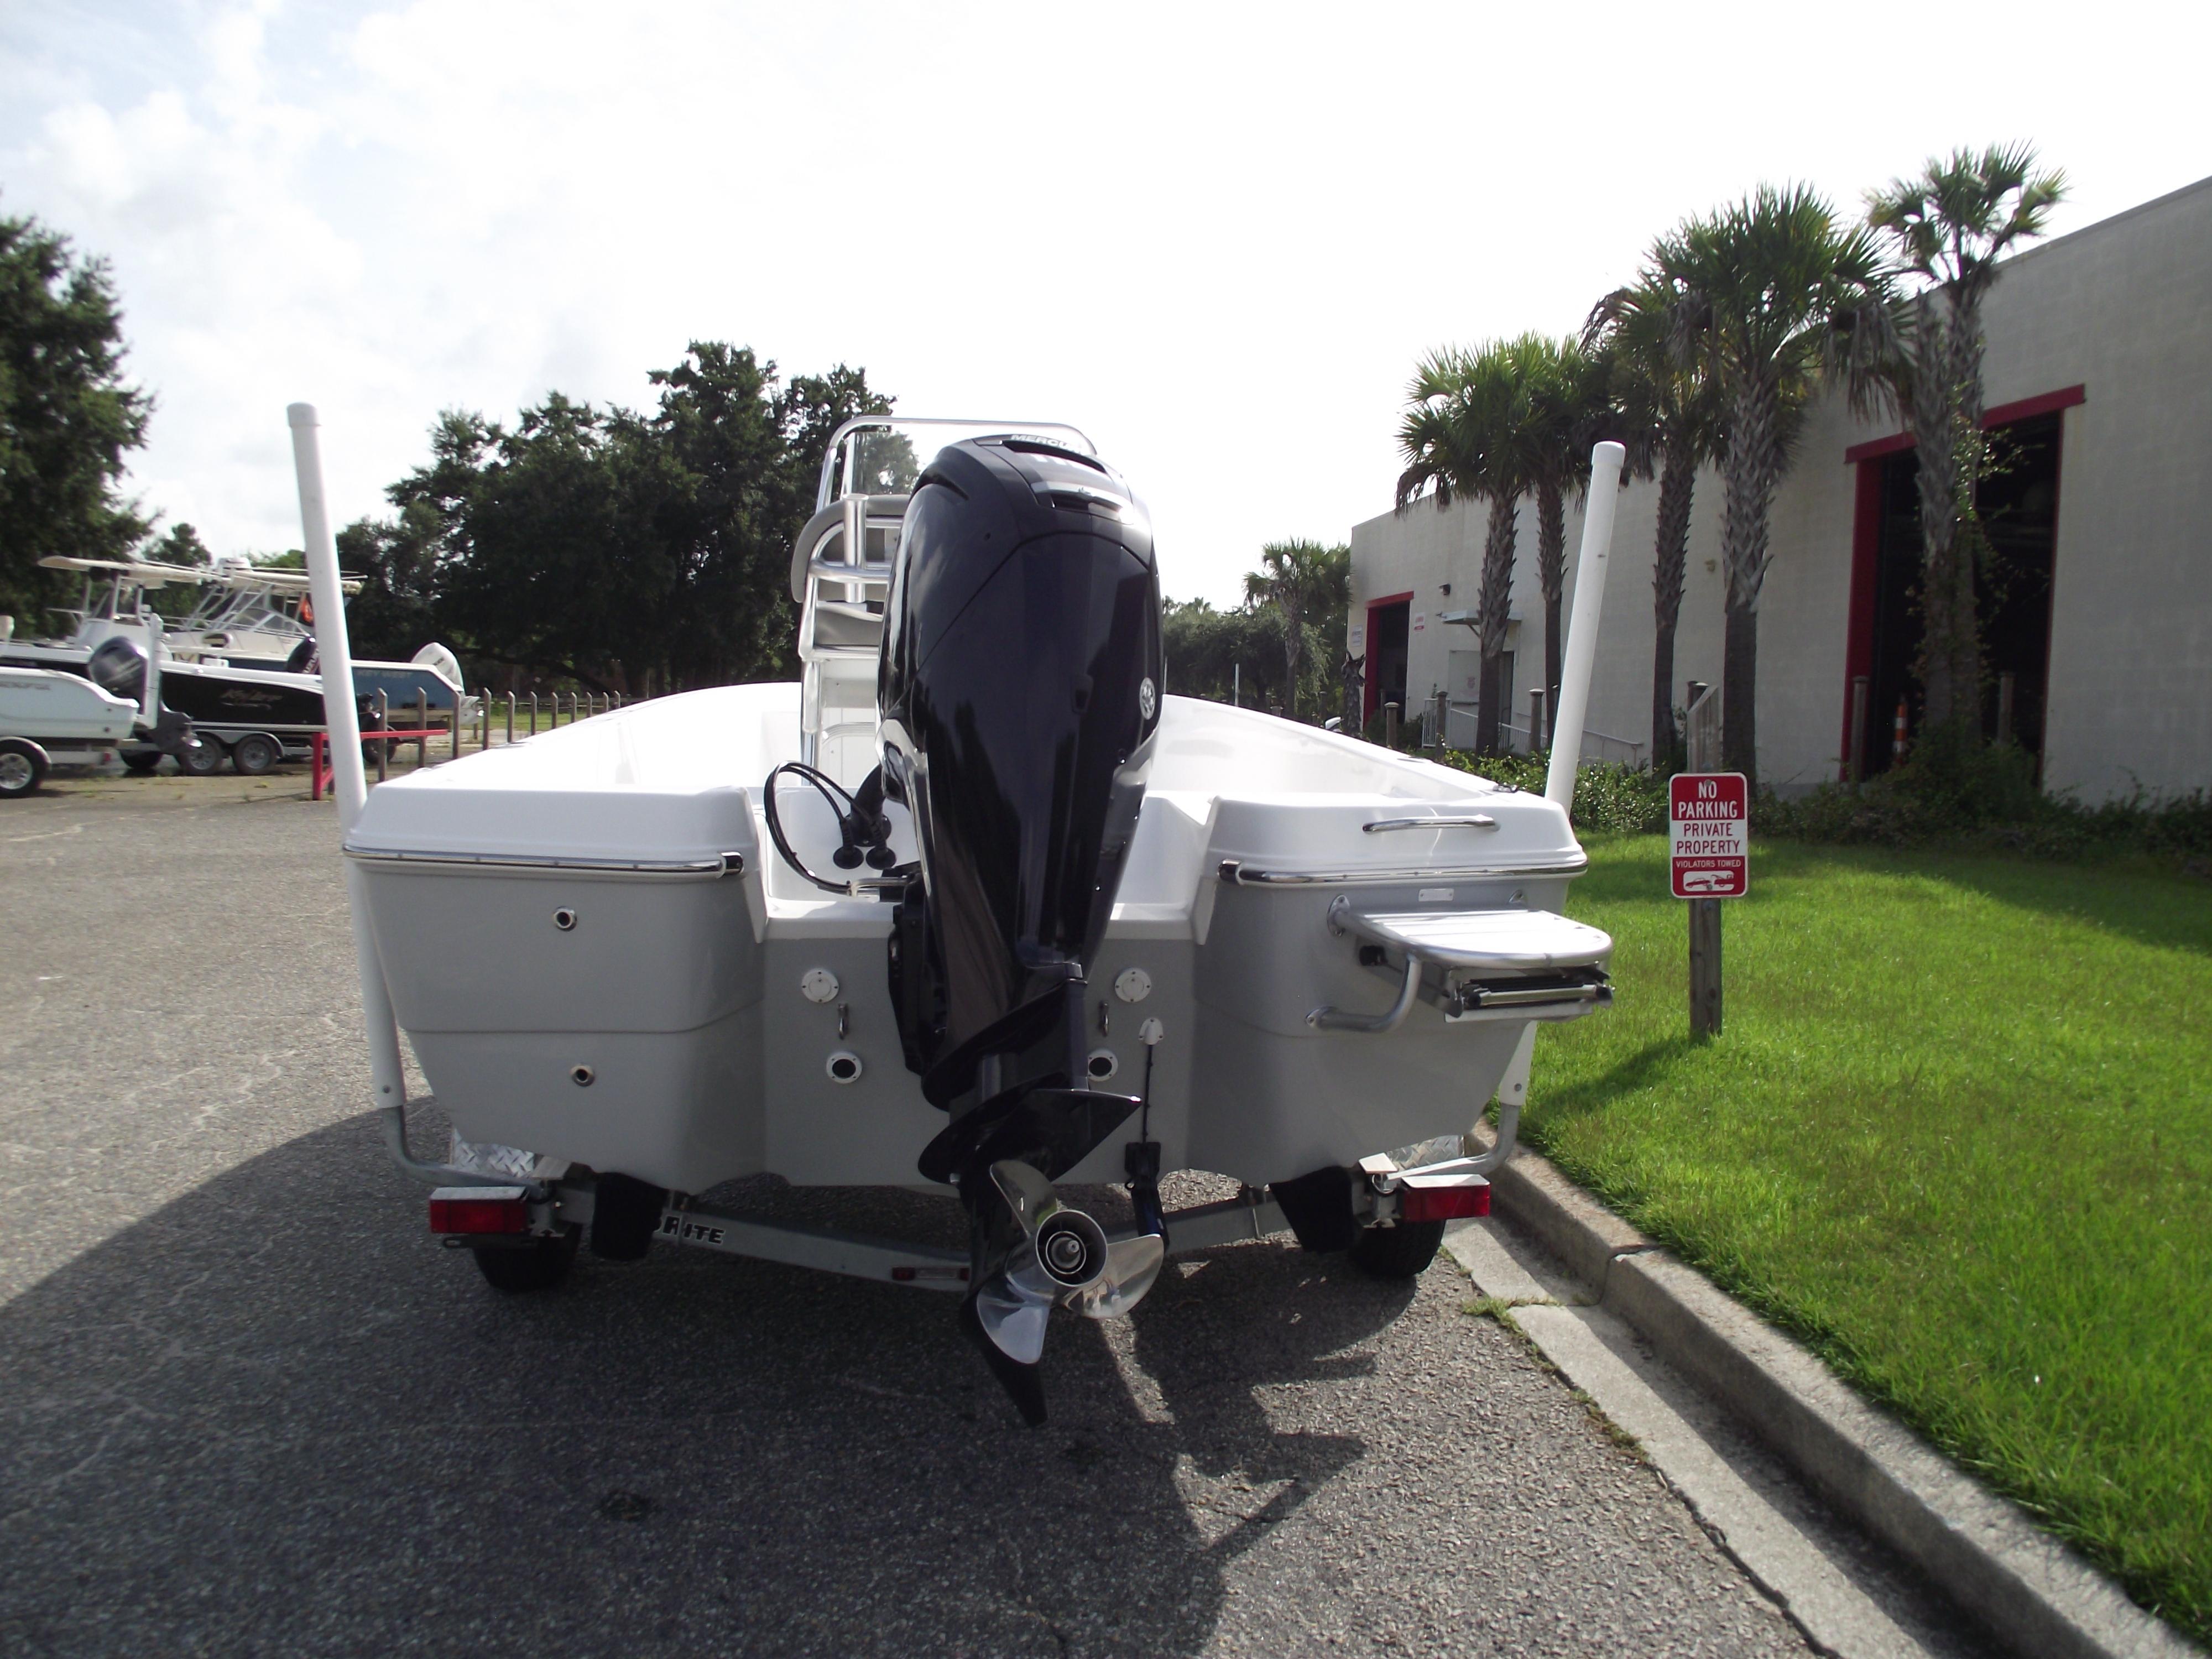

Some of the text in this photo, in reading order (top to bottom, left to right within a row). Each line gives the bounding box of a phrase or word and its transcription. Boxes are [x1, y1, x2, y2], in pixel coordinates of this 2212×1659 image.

[1011, 434, 1087, 456] MERCU
[1698, 781, 1717, 799] NO
[1678, 801, 1738, 818] PARKING
[1684, 823, 1733, 837] PRIVATE
[1677, 840, 1740, 854] PROPERTY
[1676, 859, 1741, 868] VIOLATORS TOWED
[662, 1215, 725, 1245] RITE
